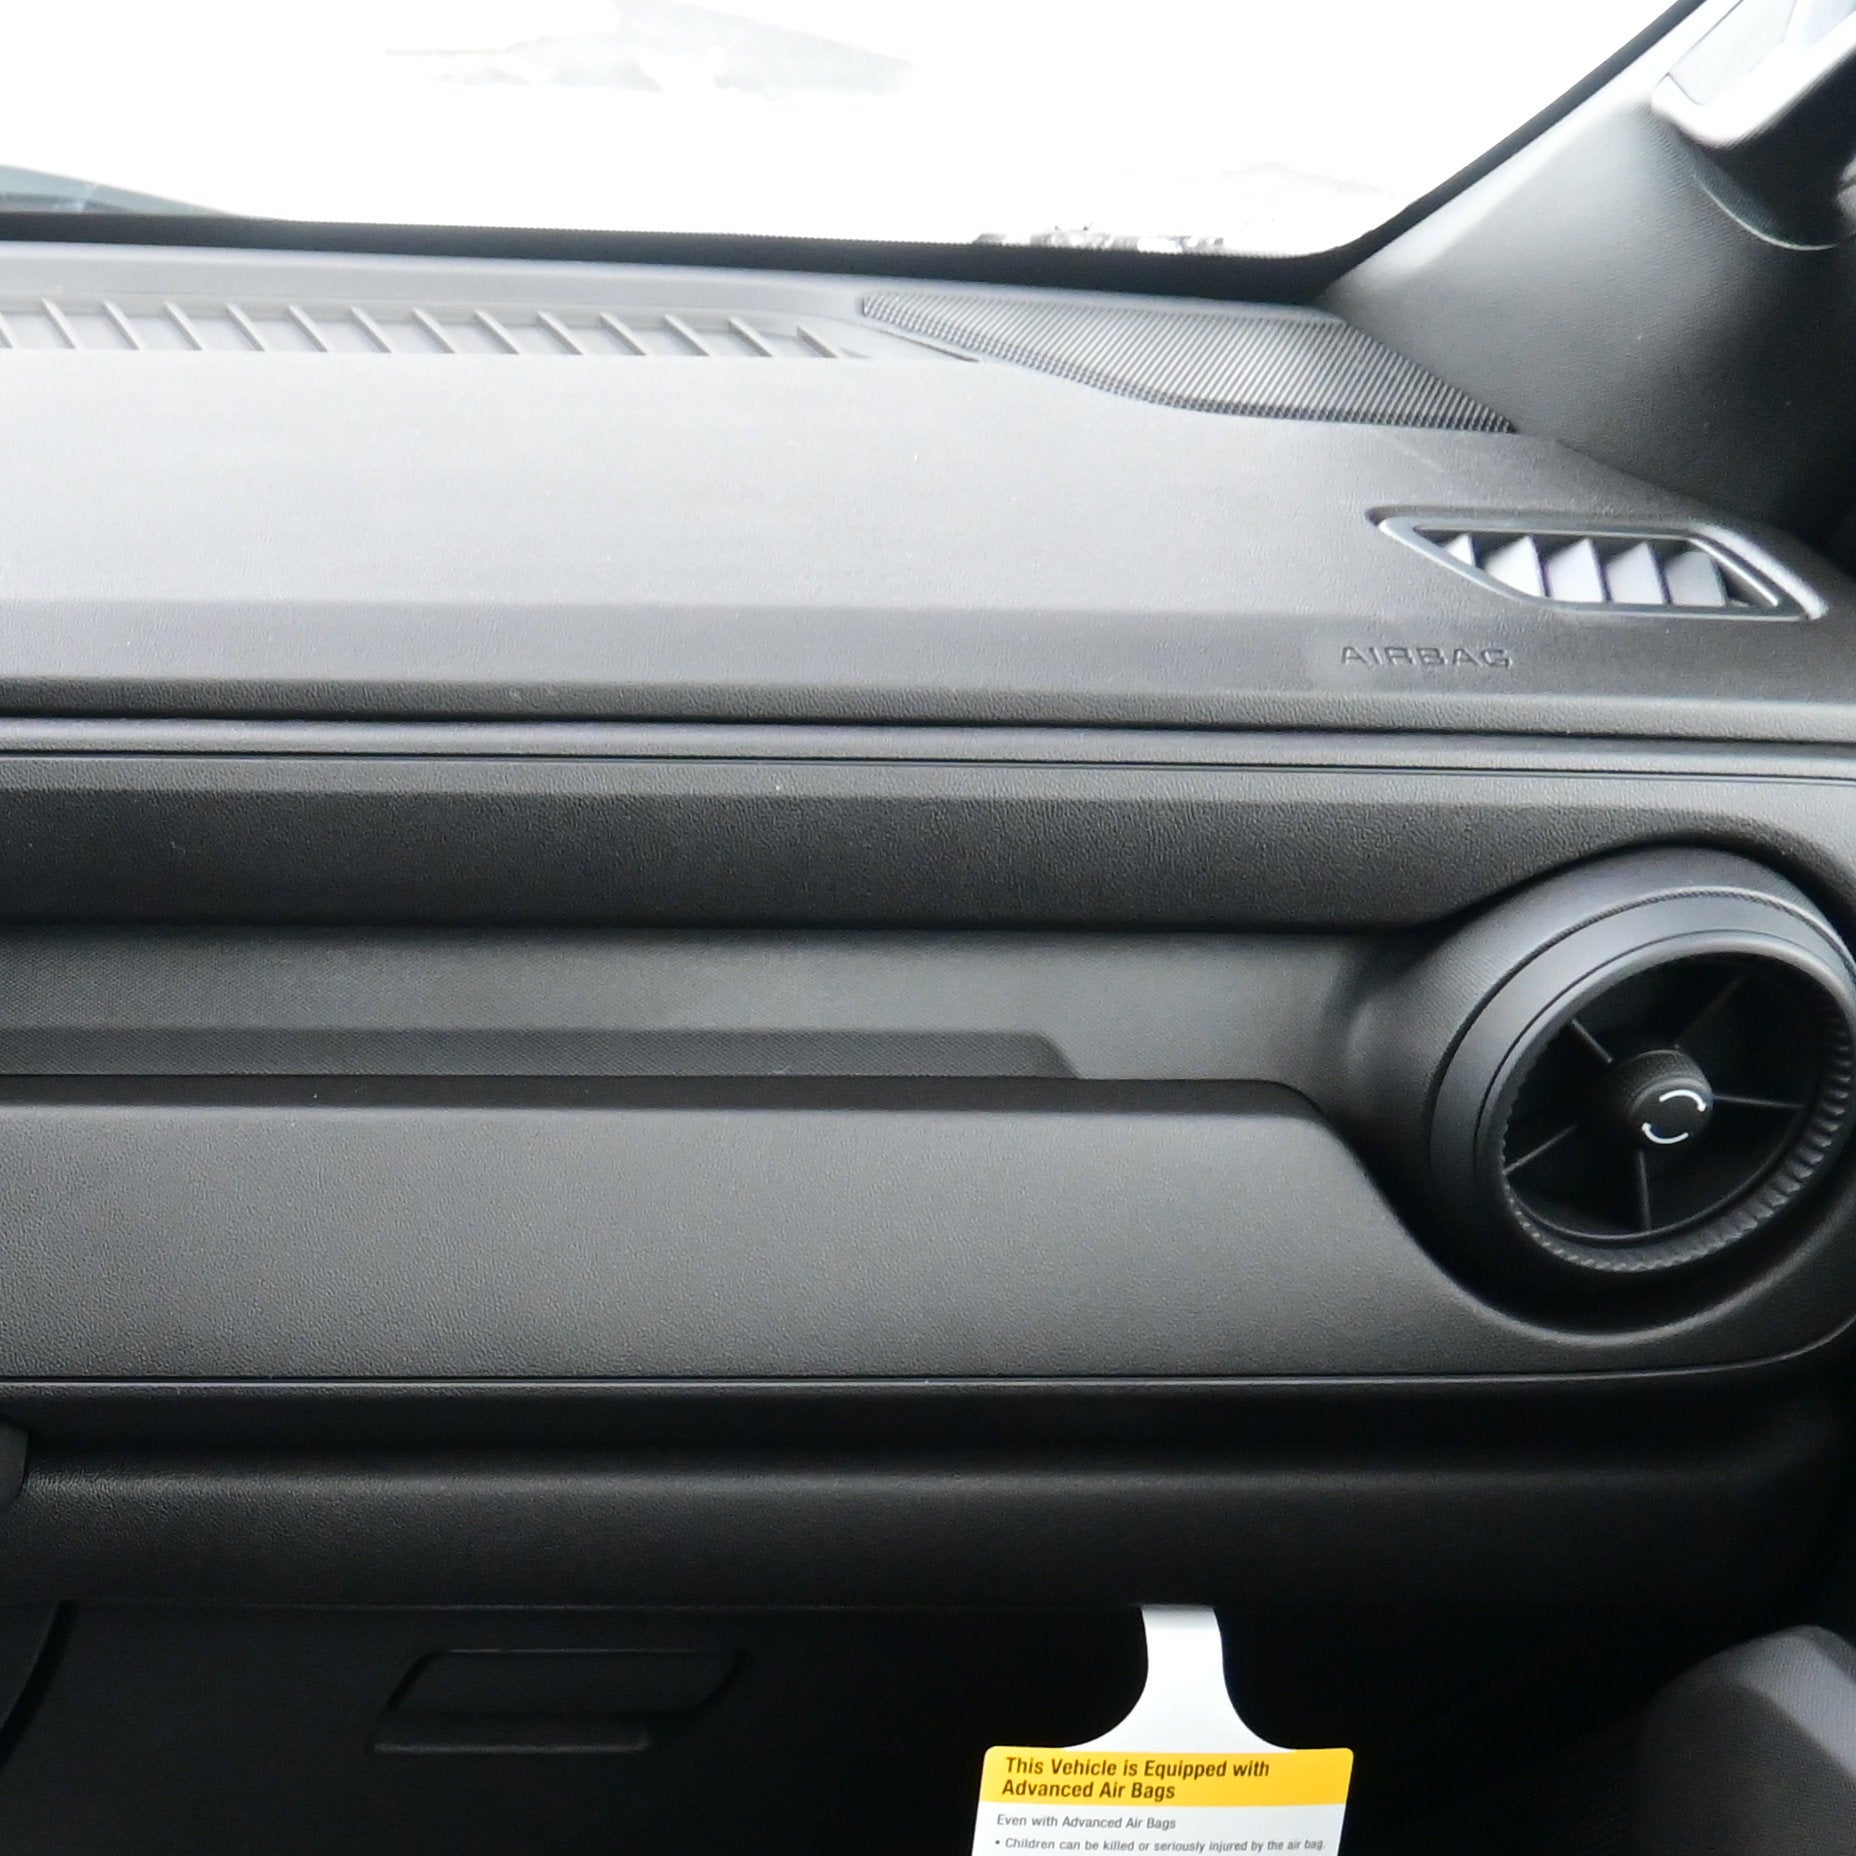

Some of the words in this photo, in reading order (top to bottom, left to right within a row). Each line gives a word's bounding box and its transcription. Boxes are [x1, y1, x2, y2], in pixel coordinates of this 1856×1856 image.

[1341, 645, 1514, 671] AIRBAG
[1005, 1757, 1043, 1774] This
[1050, 1758, 1117, 1776] Vehicle
[1122, 1760, 1138, 1776] is
[1143, 1759, 1227, 1780] Equipped
[1232, 1760, 1269, 1776] with
[1001, 1779, 1093, 1797] Advanced
[1098, 1781, 1125, 1798] Air
[1130, 1782, 1175, 1802] Bags
[996, 1813, 1027, 1826] Even
[1031, 1814, 1058, 1827] with
[1061, 1815, 1122, 1828] Advanced
[1125, 1816, 1143, 1829] Air
[1146, 1817, 1176, 1831] Bags
[1004, 1837, 1055, 1849] Children
[1058, 1840, 1080, 1850] can
[1084, 1838, 1099, 1850] be
[1102, 1839, 1134, 1851] killed
[1137, 1841, 1150, 1851] or
[1153, 1840, 1205, 1853] seriously
[1208, 1839, 1247, 1852] injured
[1250, 1840, 1263, 1853] by
[1266, 1839, 1283, 1850] the
[1286, 1839, 1300, 1850] air
